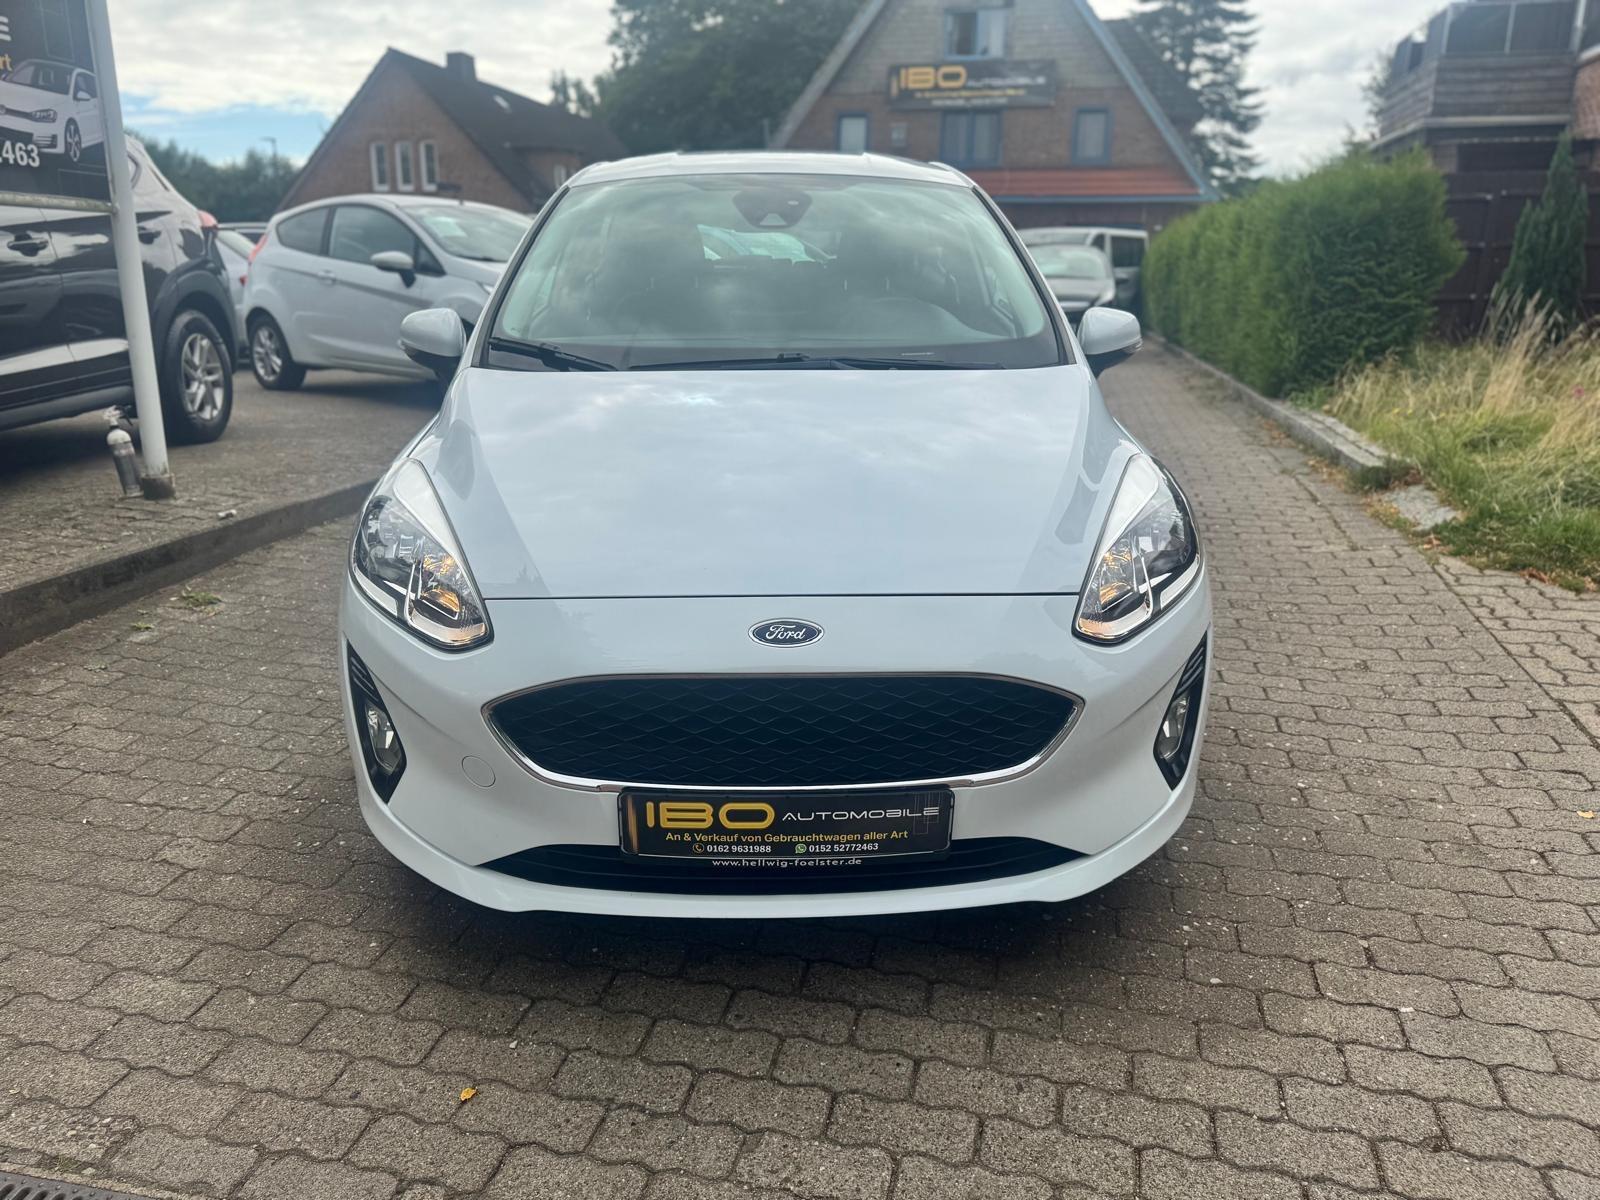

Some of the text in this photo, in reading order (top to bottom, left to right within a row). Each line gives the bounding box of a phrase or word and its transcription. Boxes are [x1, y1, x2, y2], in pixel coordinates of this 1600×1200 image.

[0, 140, 40, 168] 463
[765, 624, 806, 640] Ford
[646, 801, 940, 829] IBO AUTOMOBILE
[665, 832, 681, 841] An
[683, 833, 692, 841] &
[694, 833, 739, 842] Verkauf
[764, 833, 861, 843] Gebrauchtwagen
[863, 831, 888, 840] aller
[890, 830, 908, 839] Art
[706, 844, 772, 853] 0162 9631988
[808, 842, 879, 852] 0152 52772463
[711, 857, 862, 868] www.hellwig-foelster.de
